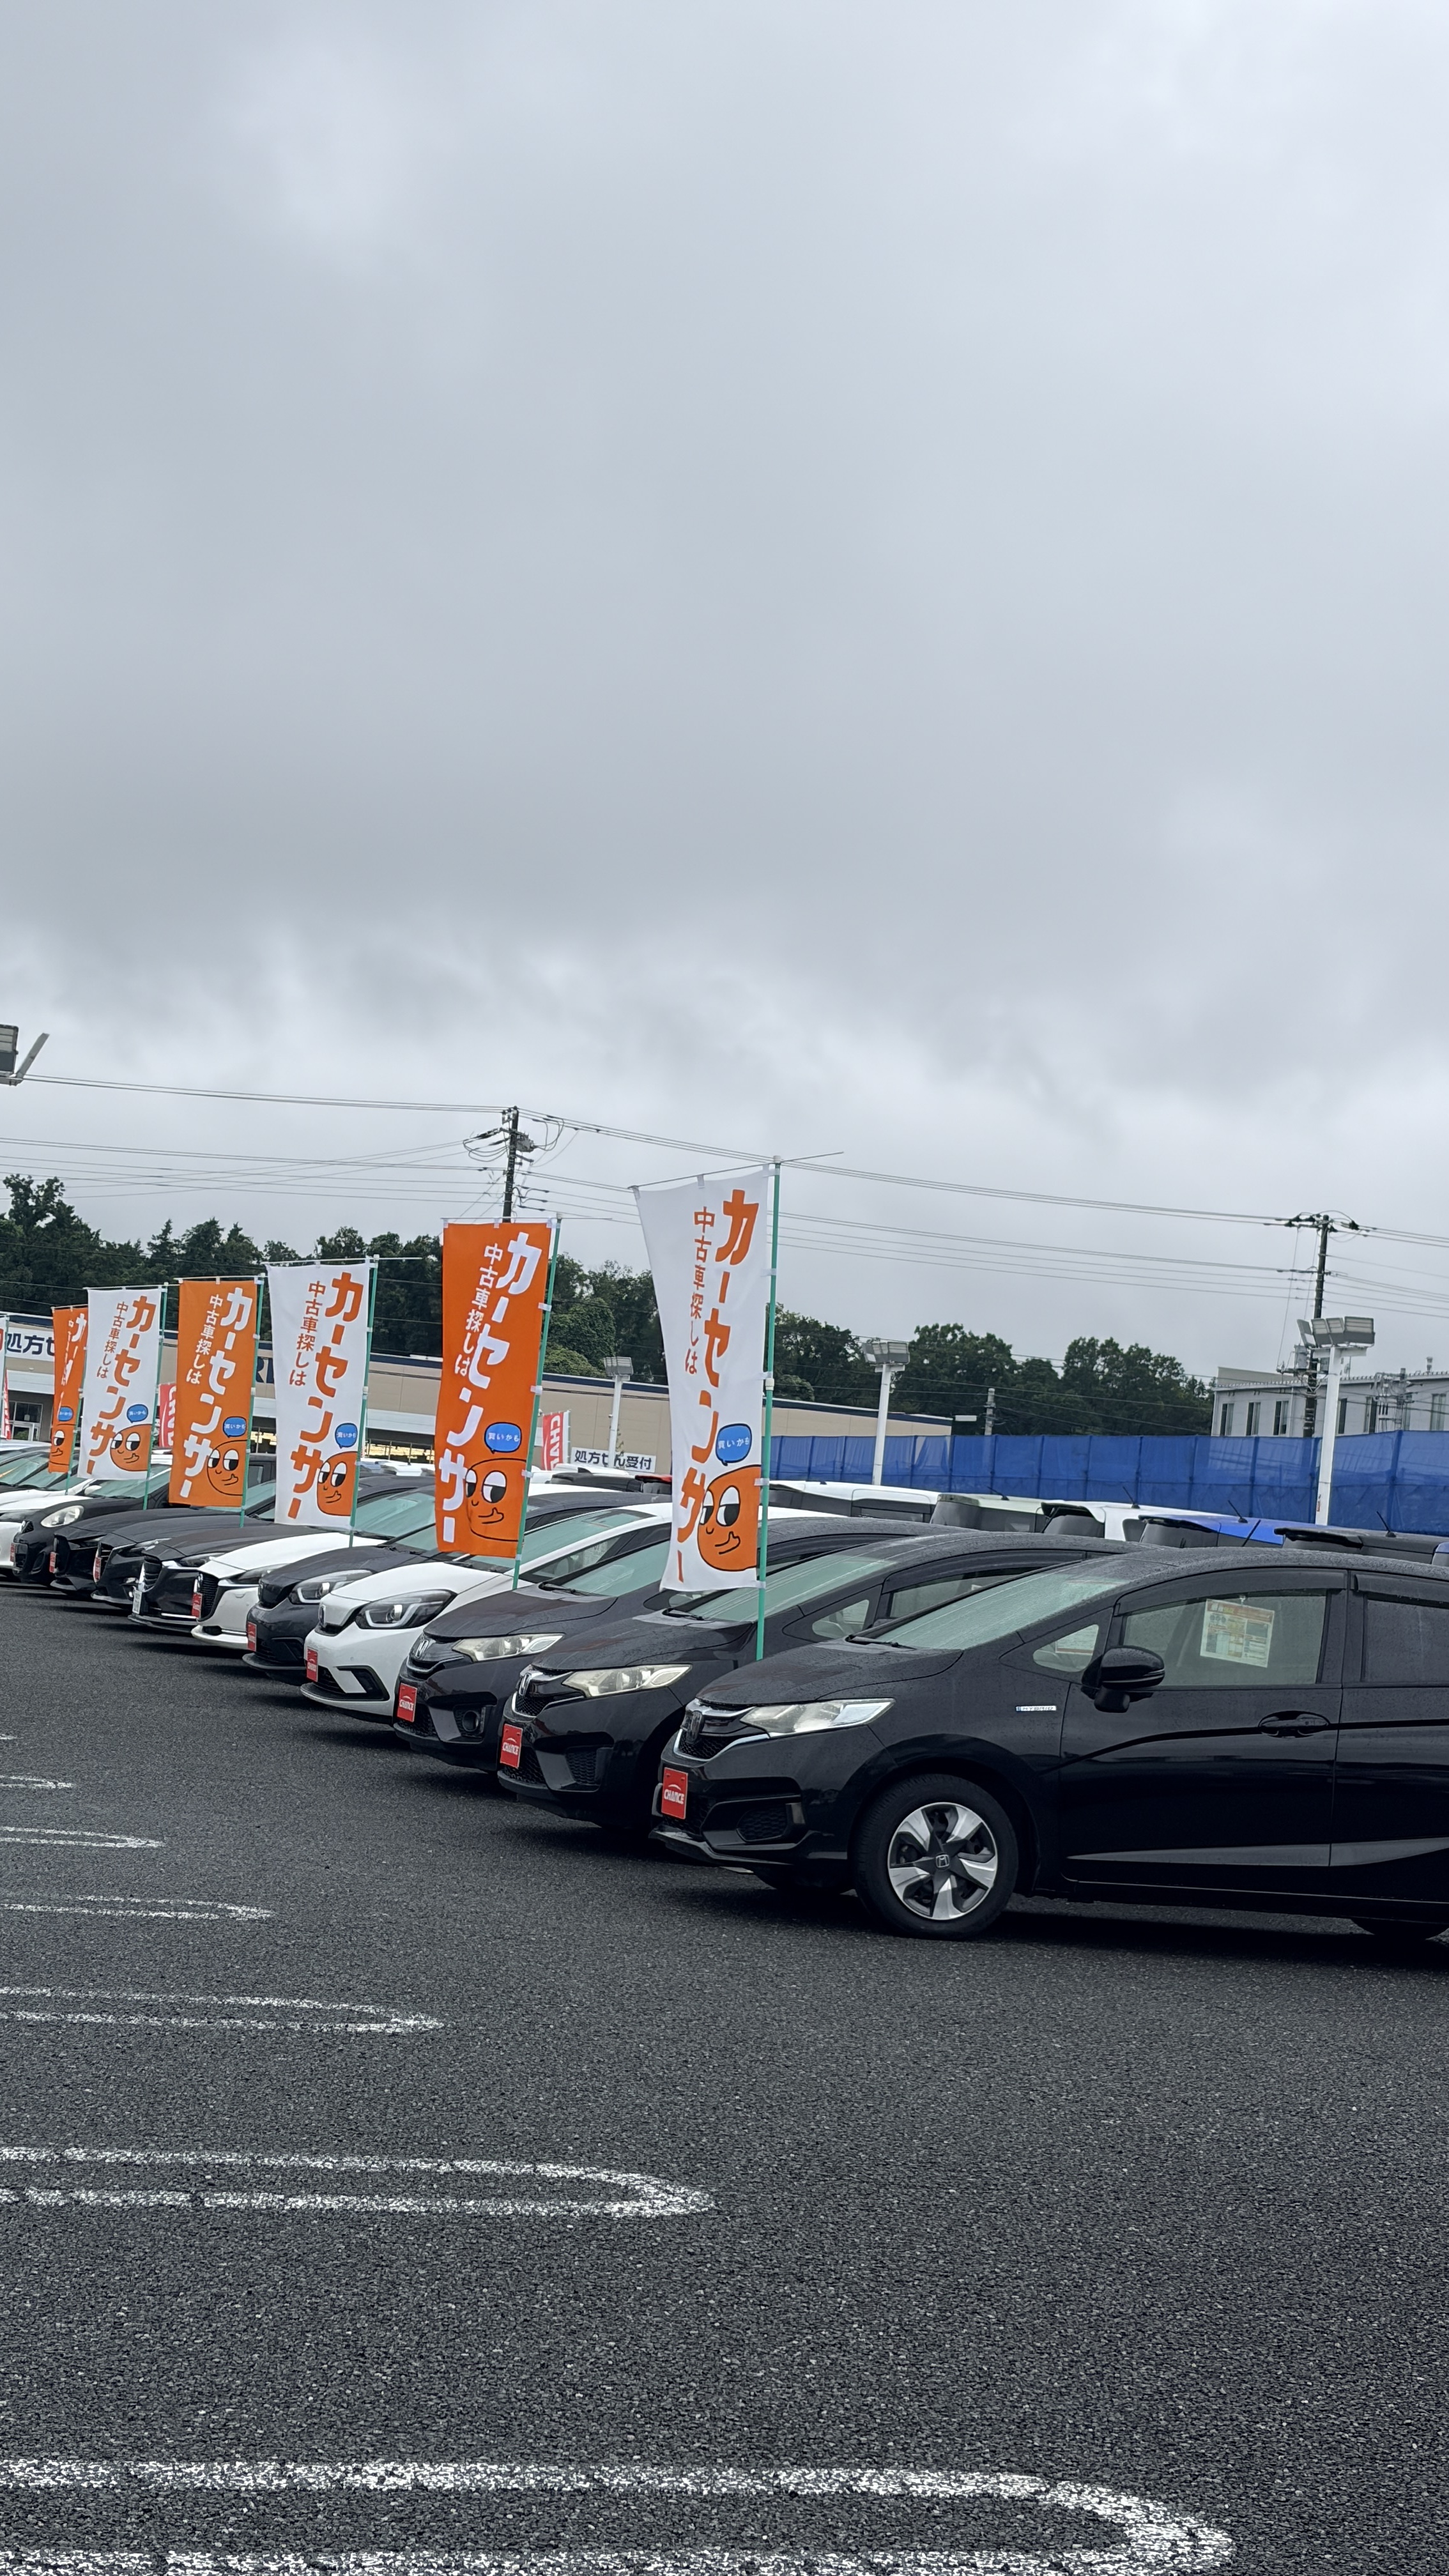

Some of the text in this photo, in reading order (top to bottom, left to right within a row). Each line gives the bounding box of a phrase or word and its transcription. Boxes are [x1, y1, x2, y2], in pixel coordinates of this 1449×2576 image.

[96, 1301, 129, 1380] 中古車探しは
[186, 1294, 224, 1385] 中古車探しは
[289, 1281, 326, 1387] 中古車探しは
[454, 1243, 502, 1377] 中古車探しは
[684, 1206, 715, 1376] 中古車探しは
[87, 1295, 157, 1475] カーセンサー
[180, 1287, 253, 1498] カーセンサー
[288, 1271, 364, 1519] カーセンサー
[438, 1231, 542, 1544] カーセンサー
[487, 1432, 520, 1443] 買いかも
[677, 1188, 759, 1583] カーセンサー
[717, 1436, 750, 1450] 買いかも
[664, 1789, 685, 1805] CHANCE
